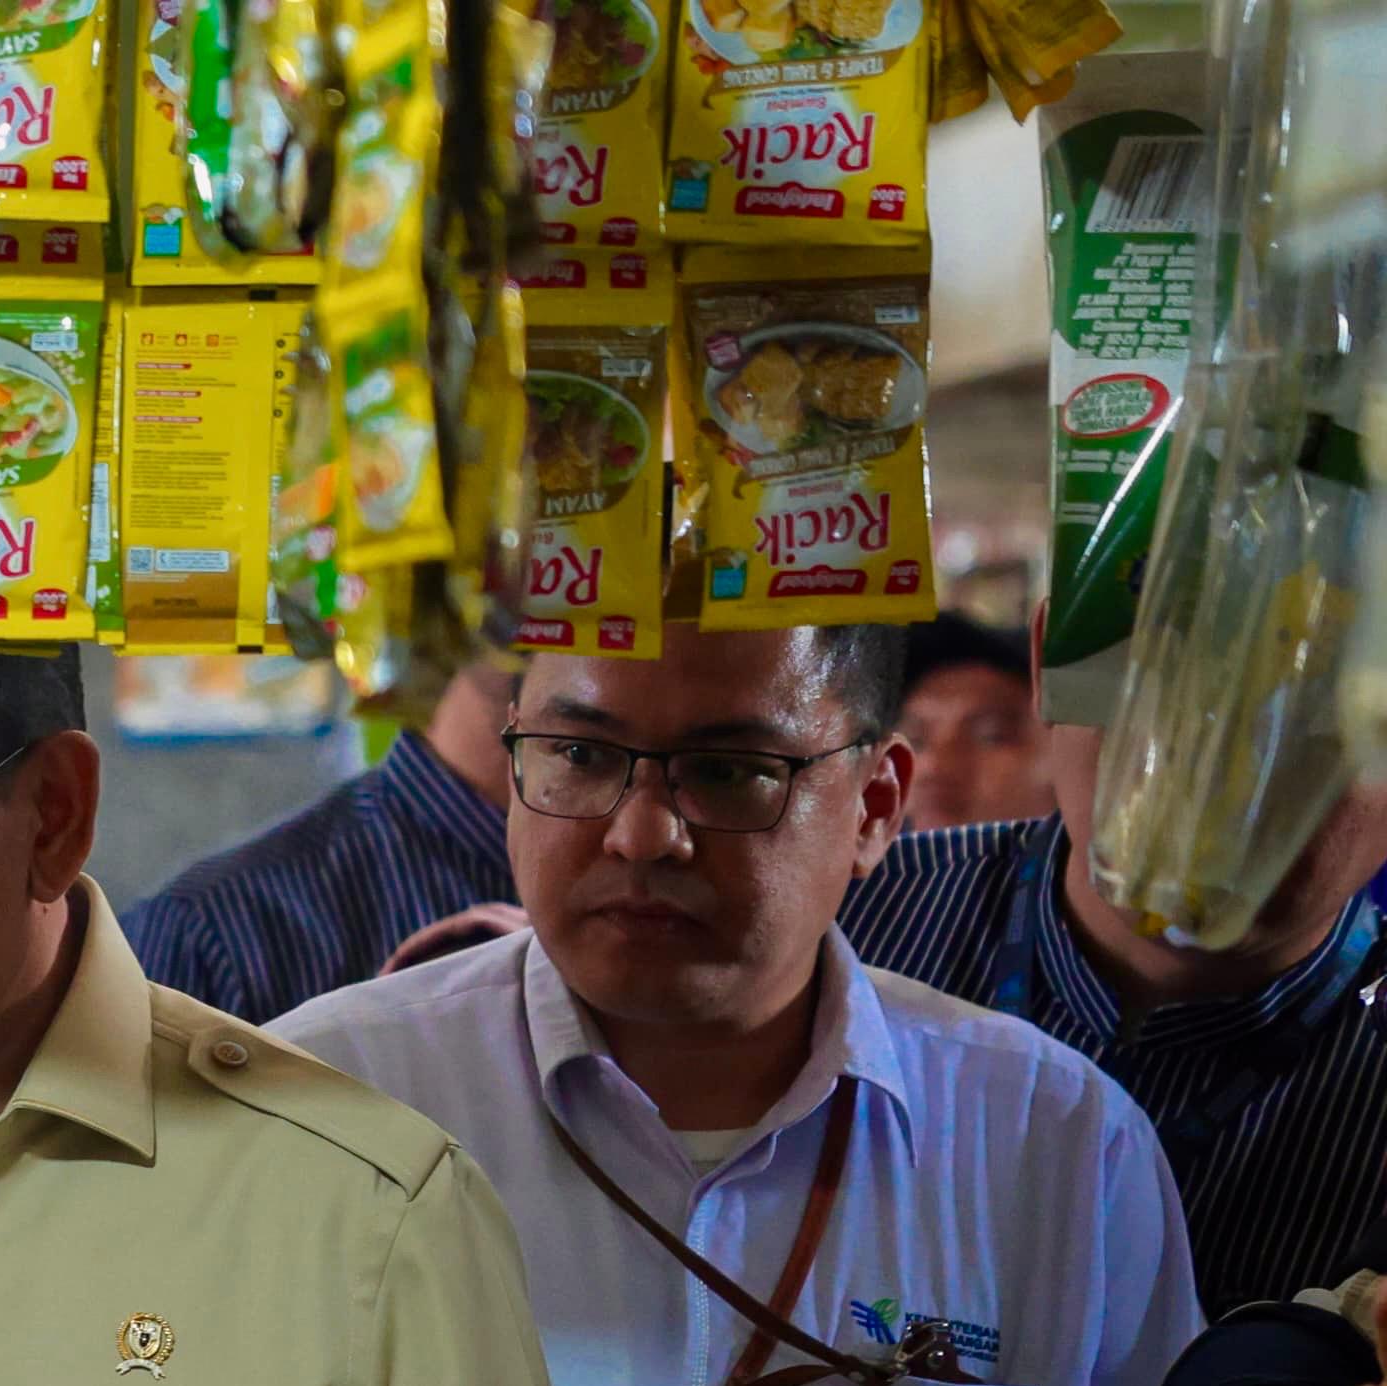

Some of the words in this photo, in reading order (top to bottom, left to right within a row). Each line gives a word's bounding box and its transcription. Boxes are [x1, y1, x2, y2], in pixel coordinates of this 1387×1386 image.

[551, 87, 615, 113] AYAM
[720, 112, 875, 180] Racik
[745, 188, 836, 212] Indofood
[543, 491, 607, 515] AYAM
[754, 493, 890, 566] Racik
[905, 1311, 1000, 1338] KETERIAN
